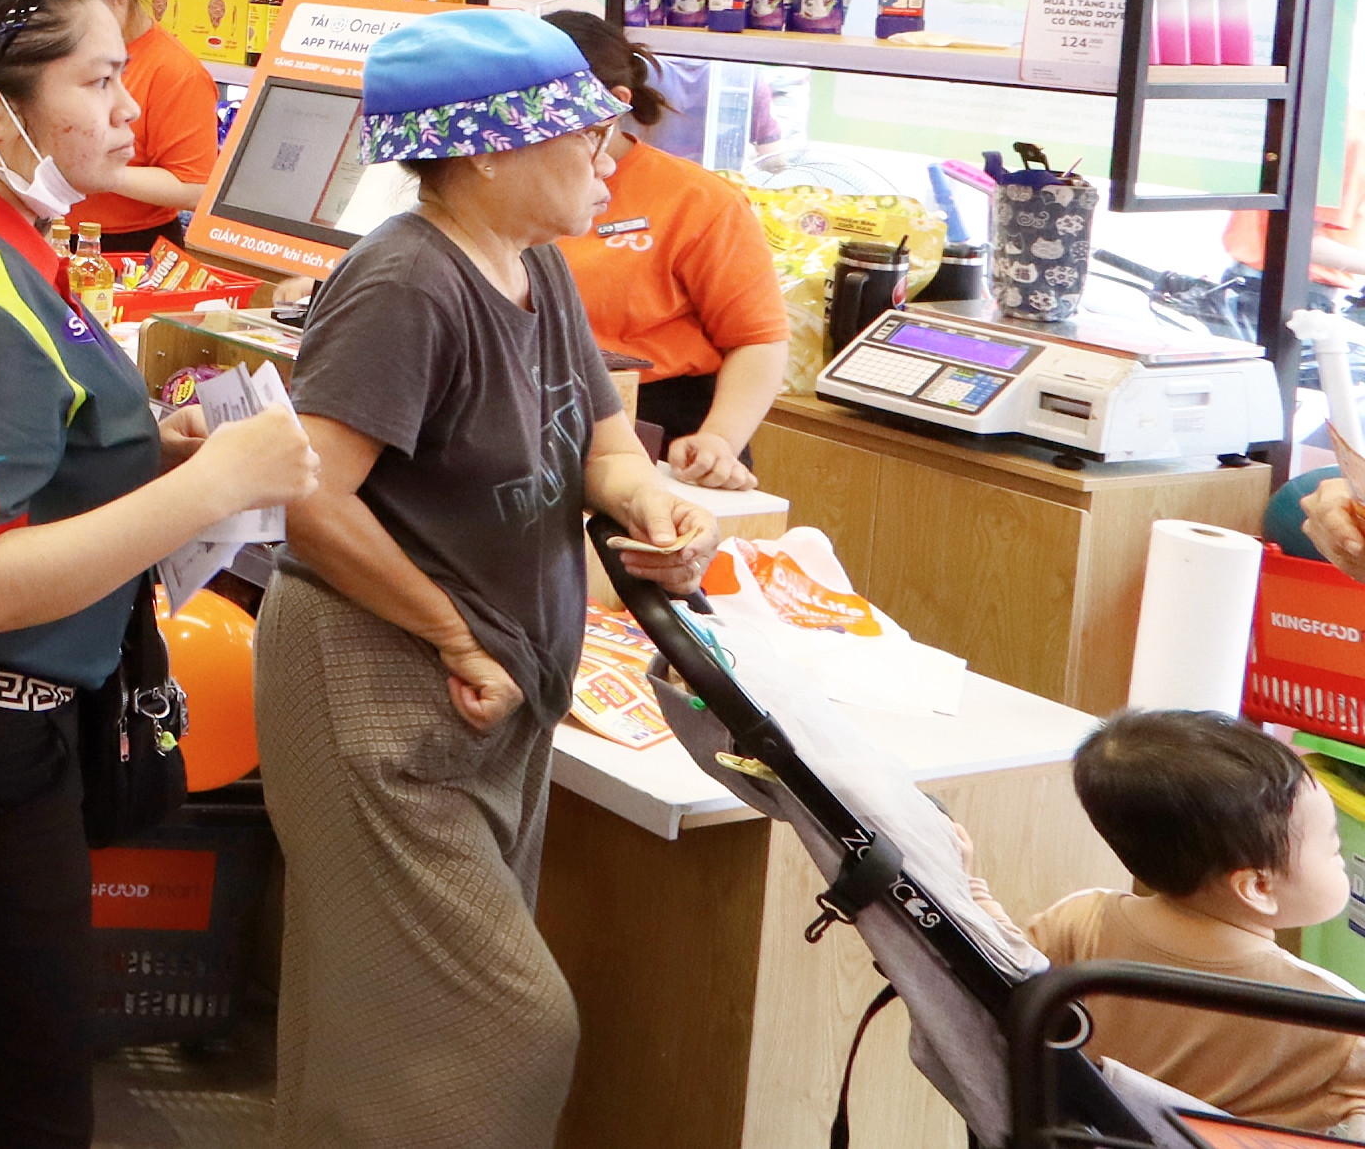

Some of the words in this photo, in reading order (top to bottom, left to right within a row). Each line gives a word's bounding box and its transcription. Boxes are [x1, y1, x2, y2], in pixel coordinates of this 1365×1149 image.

[1044, 7, 1093, 18] DIAMOND
[310, 14, 329, 28] TẢI
[1051, 16, 1065, 25] CÓ
[301, 36, 325, 47] APP
[328, 38, 369, 53] THÀNH
[209, 227, 239, 246] GIẢM
[283, 245, 302, 262] khi
[302, 249, 324, 268] tích
